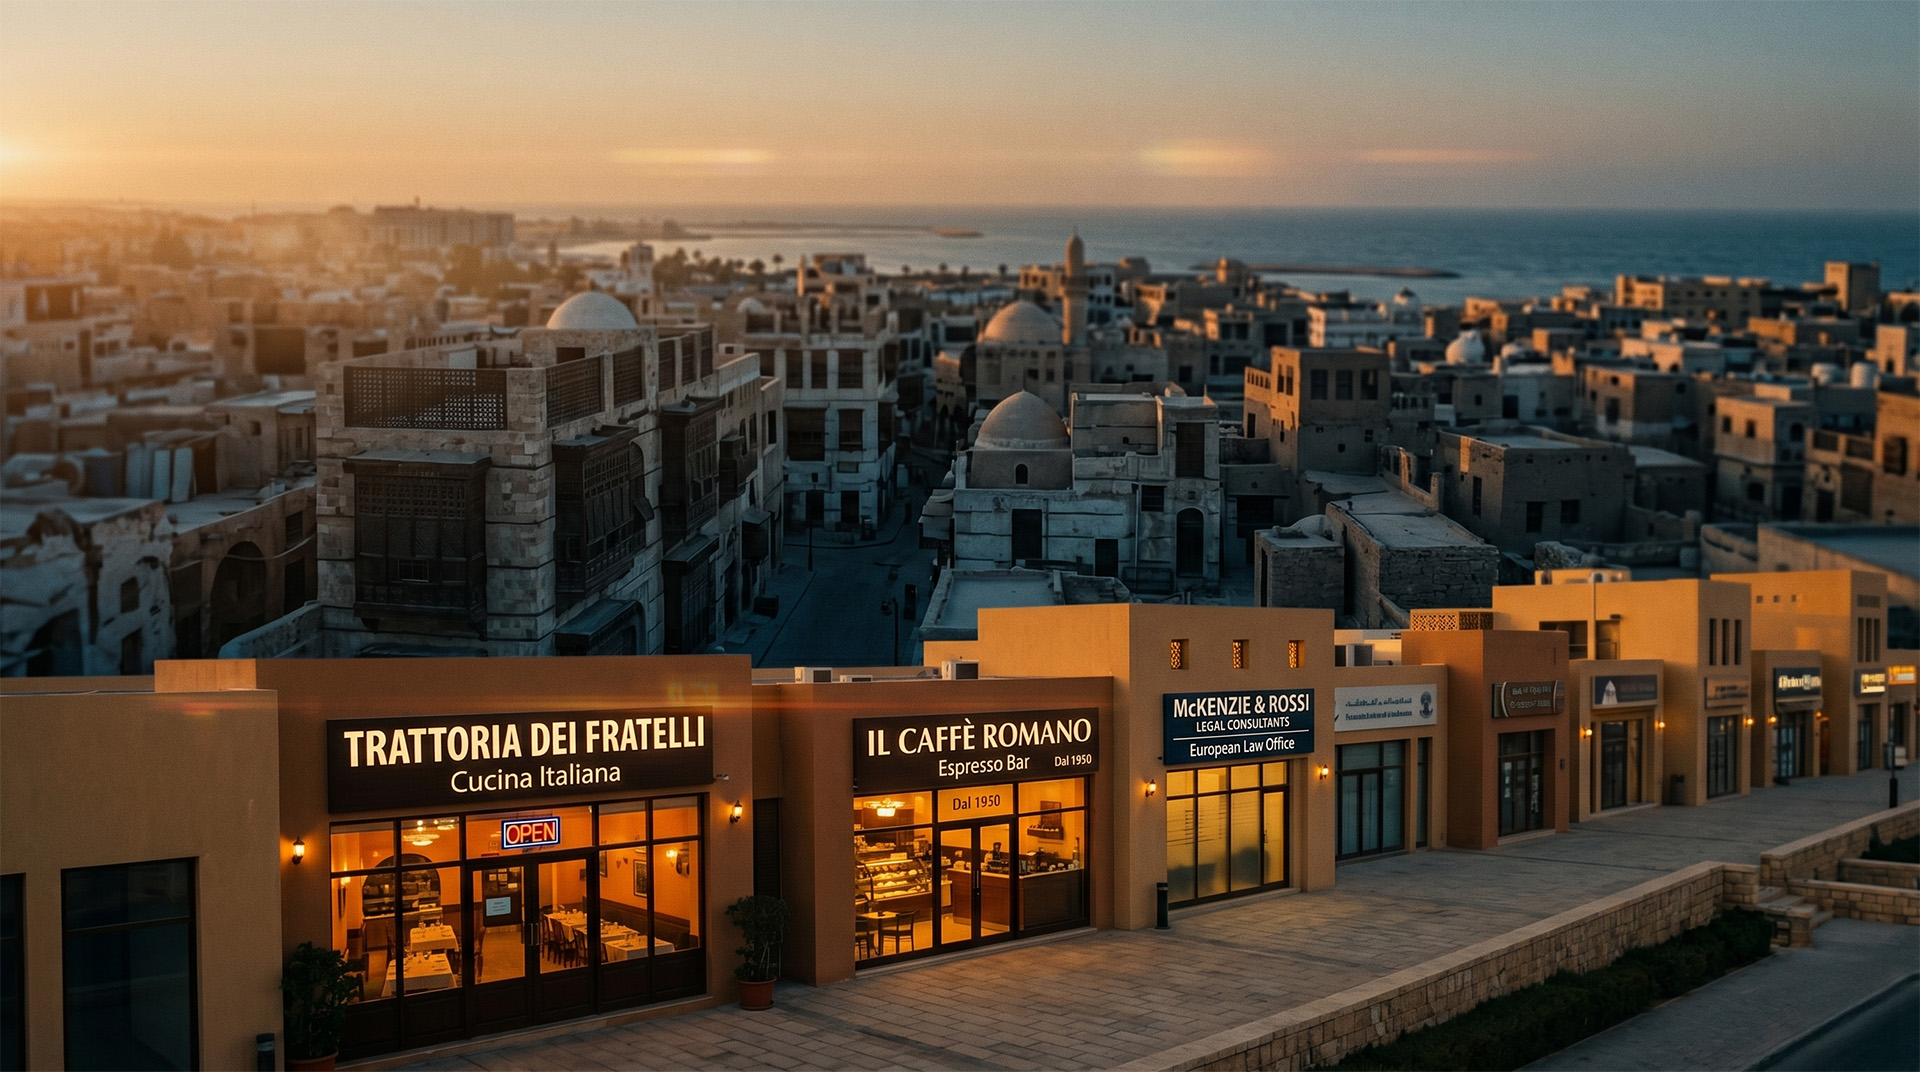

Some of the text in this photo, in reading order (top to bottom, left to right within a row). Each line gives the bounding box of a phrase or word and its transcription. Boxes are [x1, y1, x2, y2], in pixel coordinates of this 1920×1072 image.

[1173, 693, 1310, 718] McKENZIE & ROSSI
[1196, 716, 1290, 733] LEGAL CONSULTANTS
[343, 715, 705, 768] TRATTORIA DEI FRATELLI
[868, 717, 1092, 757] IL CAFFÈ ROMANO
[1190, 736, 1295, 759] European Law Office
[938, 754, 1031, 779] Espresso Bar
[1054, 753, 1092, 767] Dal 1950
[450, 762, 621, 793] Cucina Italiana
[952, 794, 1001, 811] Dal 1950
[506, 821, 556, 845] OPEN
